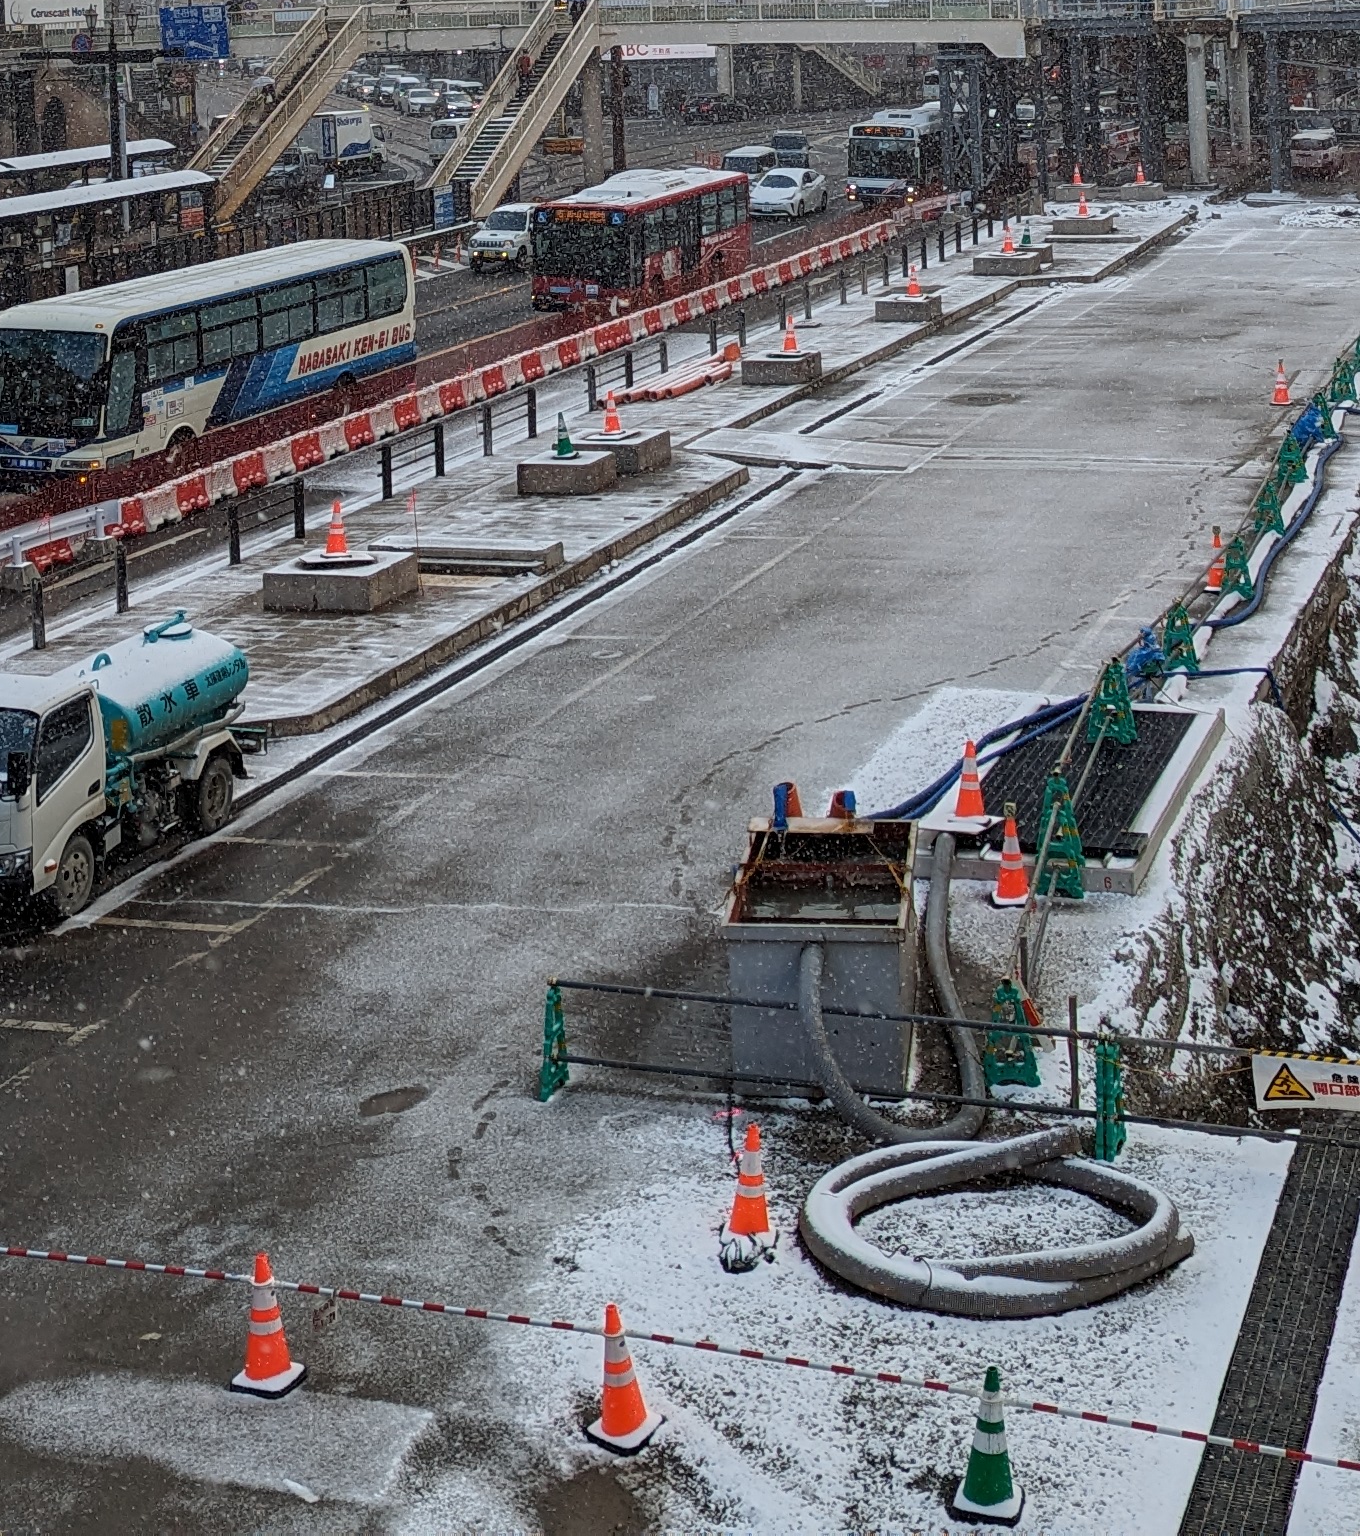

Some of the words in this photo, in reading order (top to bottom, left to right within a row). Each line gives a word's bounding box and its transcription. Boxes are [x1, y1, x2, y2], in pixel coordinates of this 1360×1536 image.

[30, 7, 70, 18] Coruscant
[297, 341, 352, 375] NAGASAKI
[391, 322, 411, 344] BUS
[135, 678, 200, 729] 散水車
